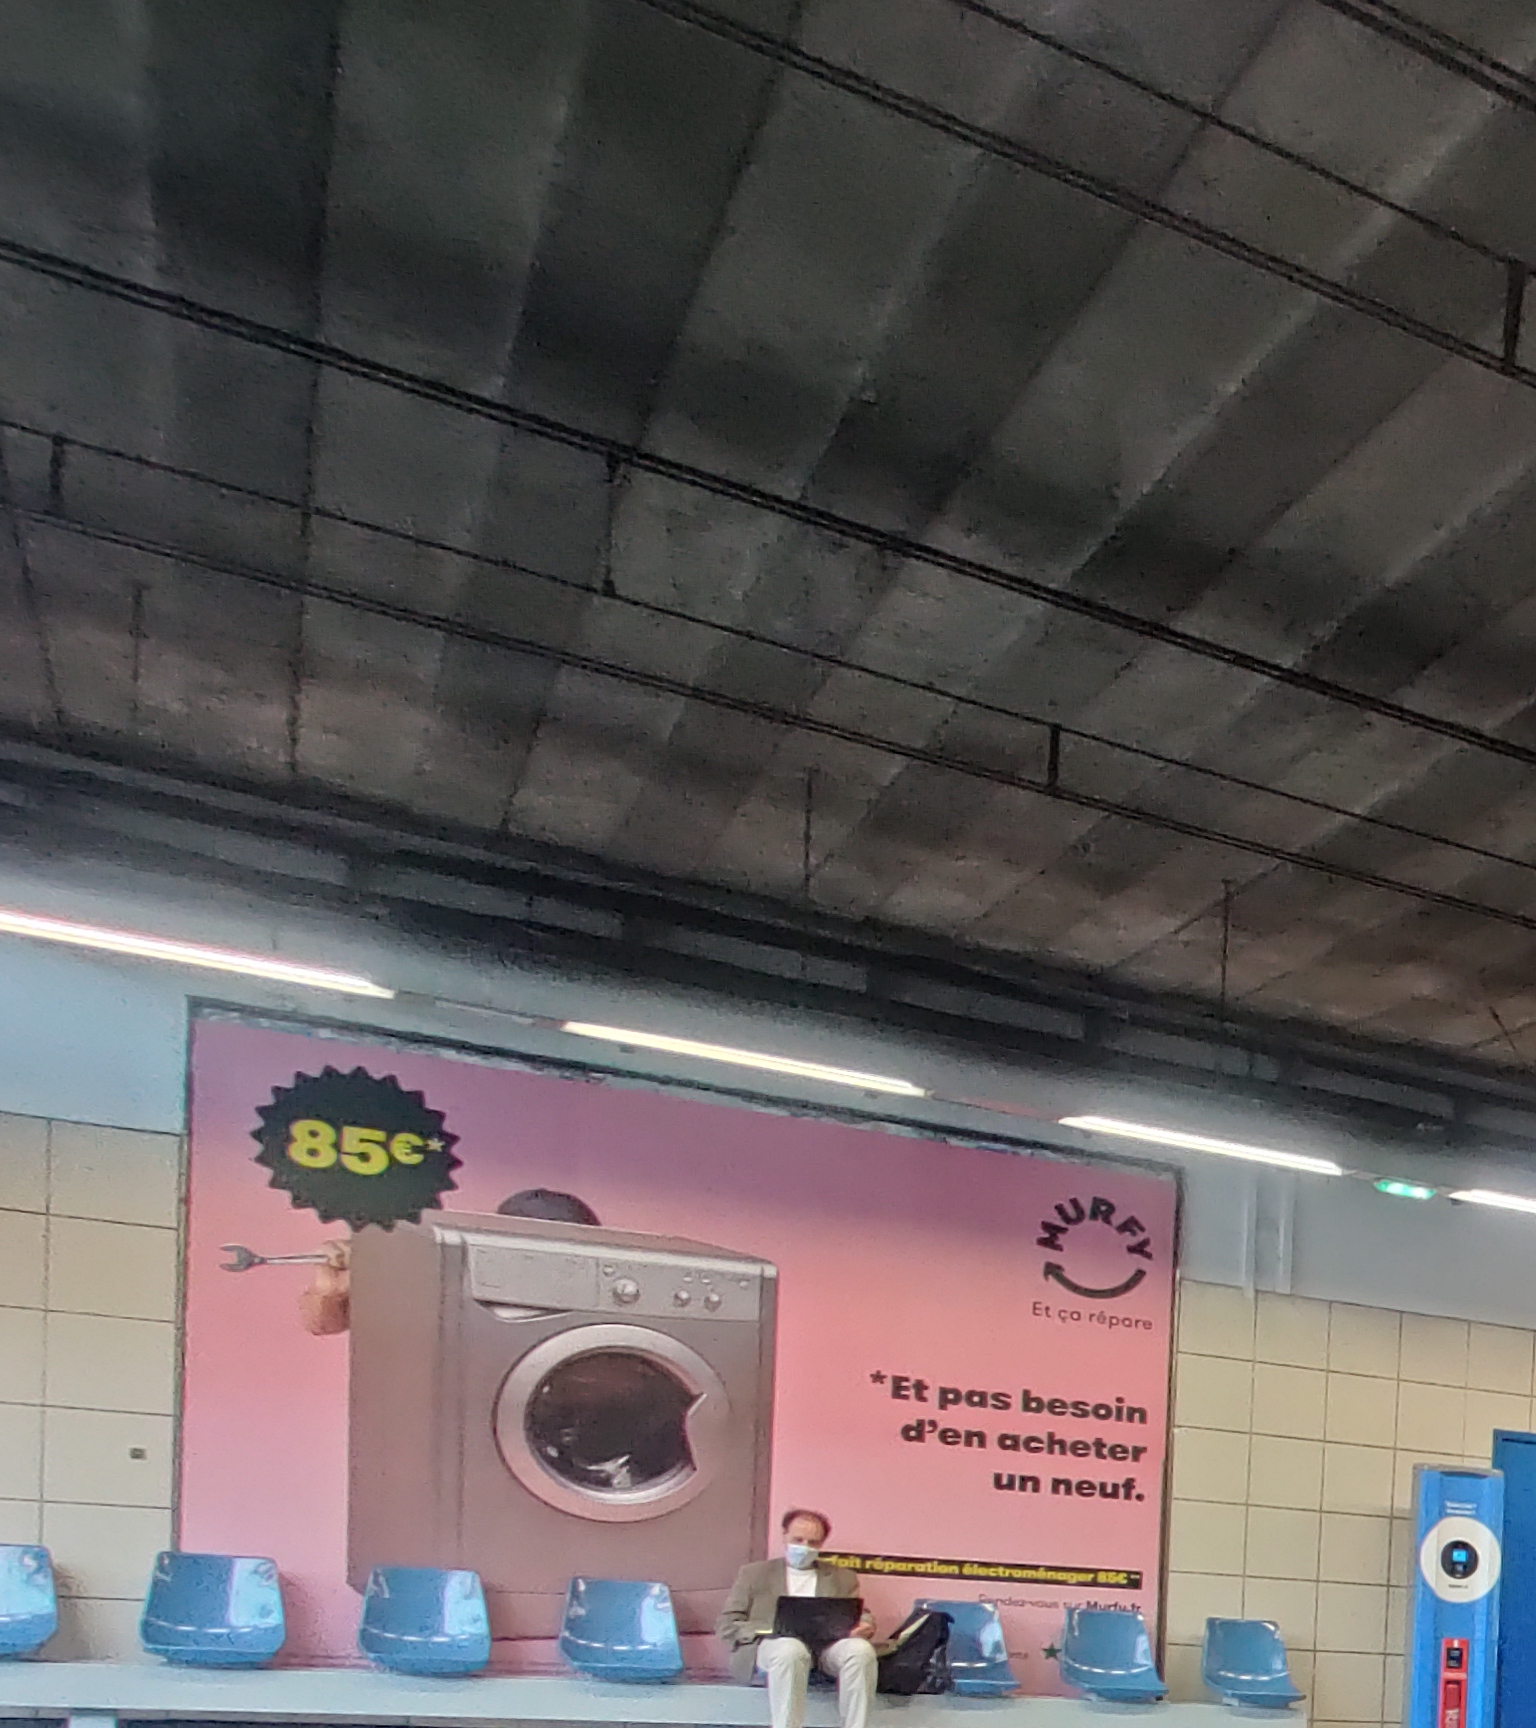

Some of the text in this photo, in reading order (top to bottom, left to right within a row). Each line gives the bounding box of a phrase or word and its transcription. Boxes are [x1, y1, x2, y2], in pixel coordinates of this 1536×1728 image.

[1036, 1196, 1153, 1260] MURFY
[1032, 1301, 1153, 1330] Et ça répare
[937, 1385, 1013, 1411] pas
[1021, 1388, 1148, 1425] besoin
[900, 1418, 1148, 1463] d’en acheter
[993, 1471, 1146, 1502] un neuf.
[865, 1556, 959, 1576] réparation
[961, 1560, 1095, 1584] électroménager
